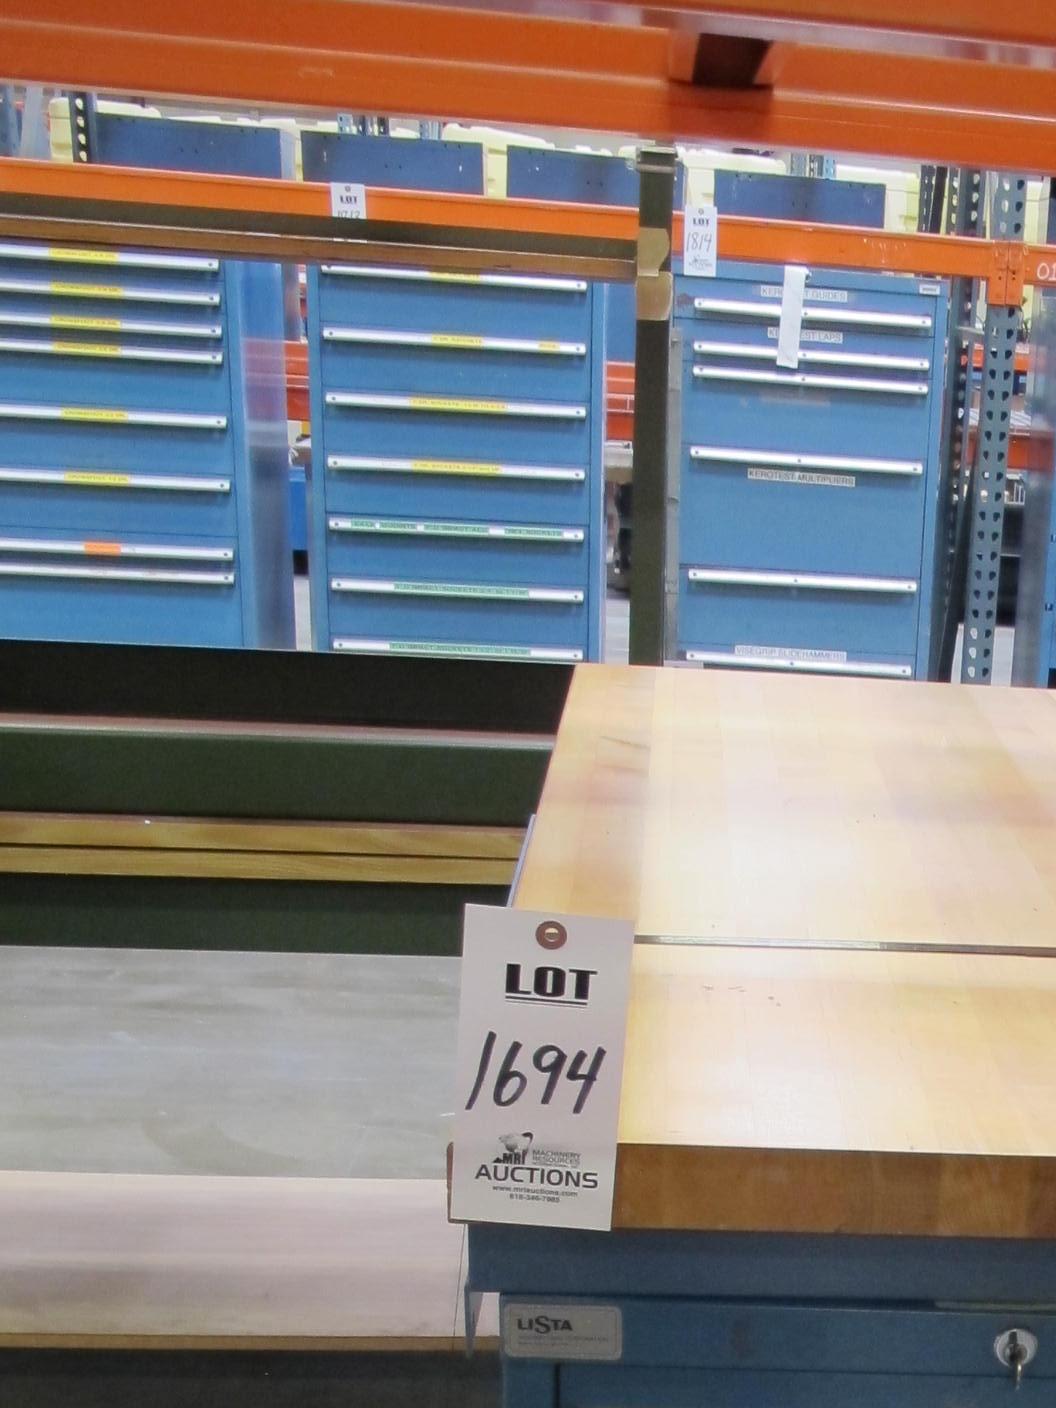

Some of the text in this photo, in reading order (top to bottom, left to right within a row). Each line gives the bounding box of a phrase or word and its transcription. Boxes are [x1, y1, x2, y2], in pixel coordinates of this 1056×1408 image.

[340, 194, 357, 204] LOT
[693, 218, 710, 226] LOT
[687, 231, 712, 252] 1814
[749, 469, 796, 482] KEROTEST
[505, 963, 598, 1001] LOT
[465, 1030, 607, 1114] 1694
[502, 1149, 528, 1165] MRI
[532, 1148, 581, 1160] MACHINERY
[474, 1164, 598, 1189] AUCTIONS
[517, 1315, 573, 1334] LISTA
